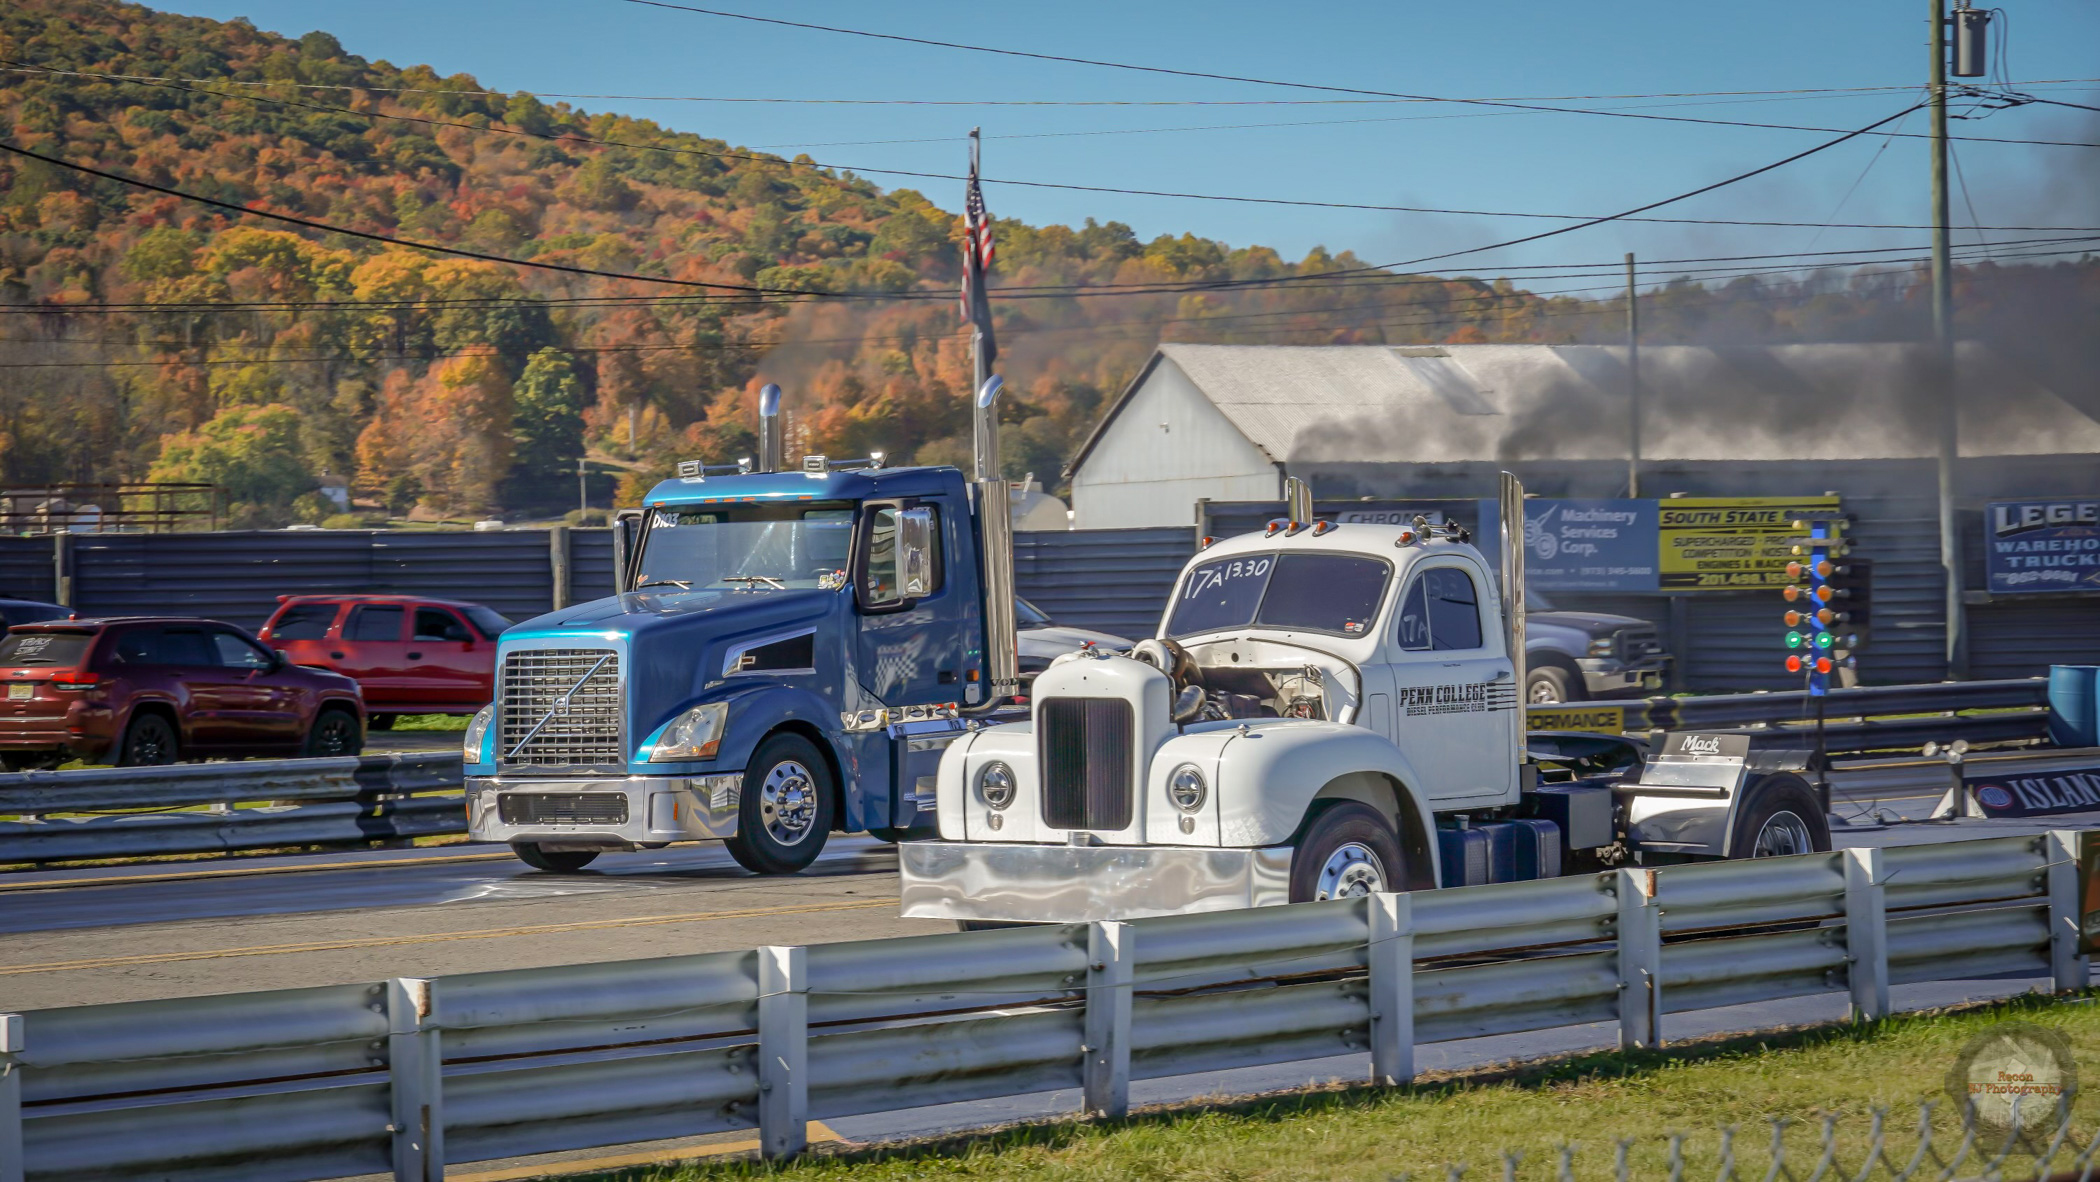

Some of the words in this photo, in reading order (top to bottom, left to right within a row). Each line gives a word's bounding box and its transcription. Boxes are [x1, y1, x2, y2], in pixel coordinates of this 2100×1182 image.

[652, 510, 680, 528] D103
[1561, 508, 1637, 526] Machinery
[1663, 511, 1721, 524] SOUTH
[1726, 510, 1778, 523] STATE
[1561, 526, 1618, 539] Services
[1561, 541, 1598, 557] Corp.
[1673, 536, 1756, 547] SUPERCHARGED
[1682, 549, 1752, 558] COMPETITION
[1224, 559, 1270, 580] 13.30
[1697, 560, 1740, 569] ENGINES
[1400, 686, 1434, 707] PENN
[1436, 683, 1486, 704] COLLEGE
[1680, 735, 1721, 755] Mack
